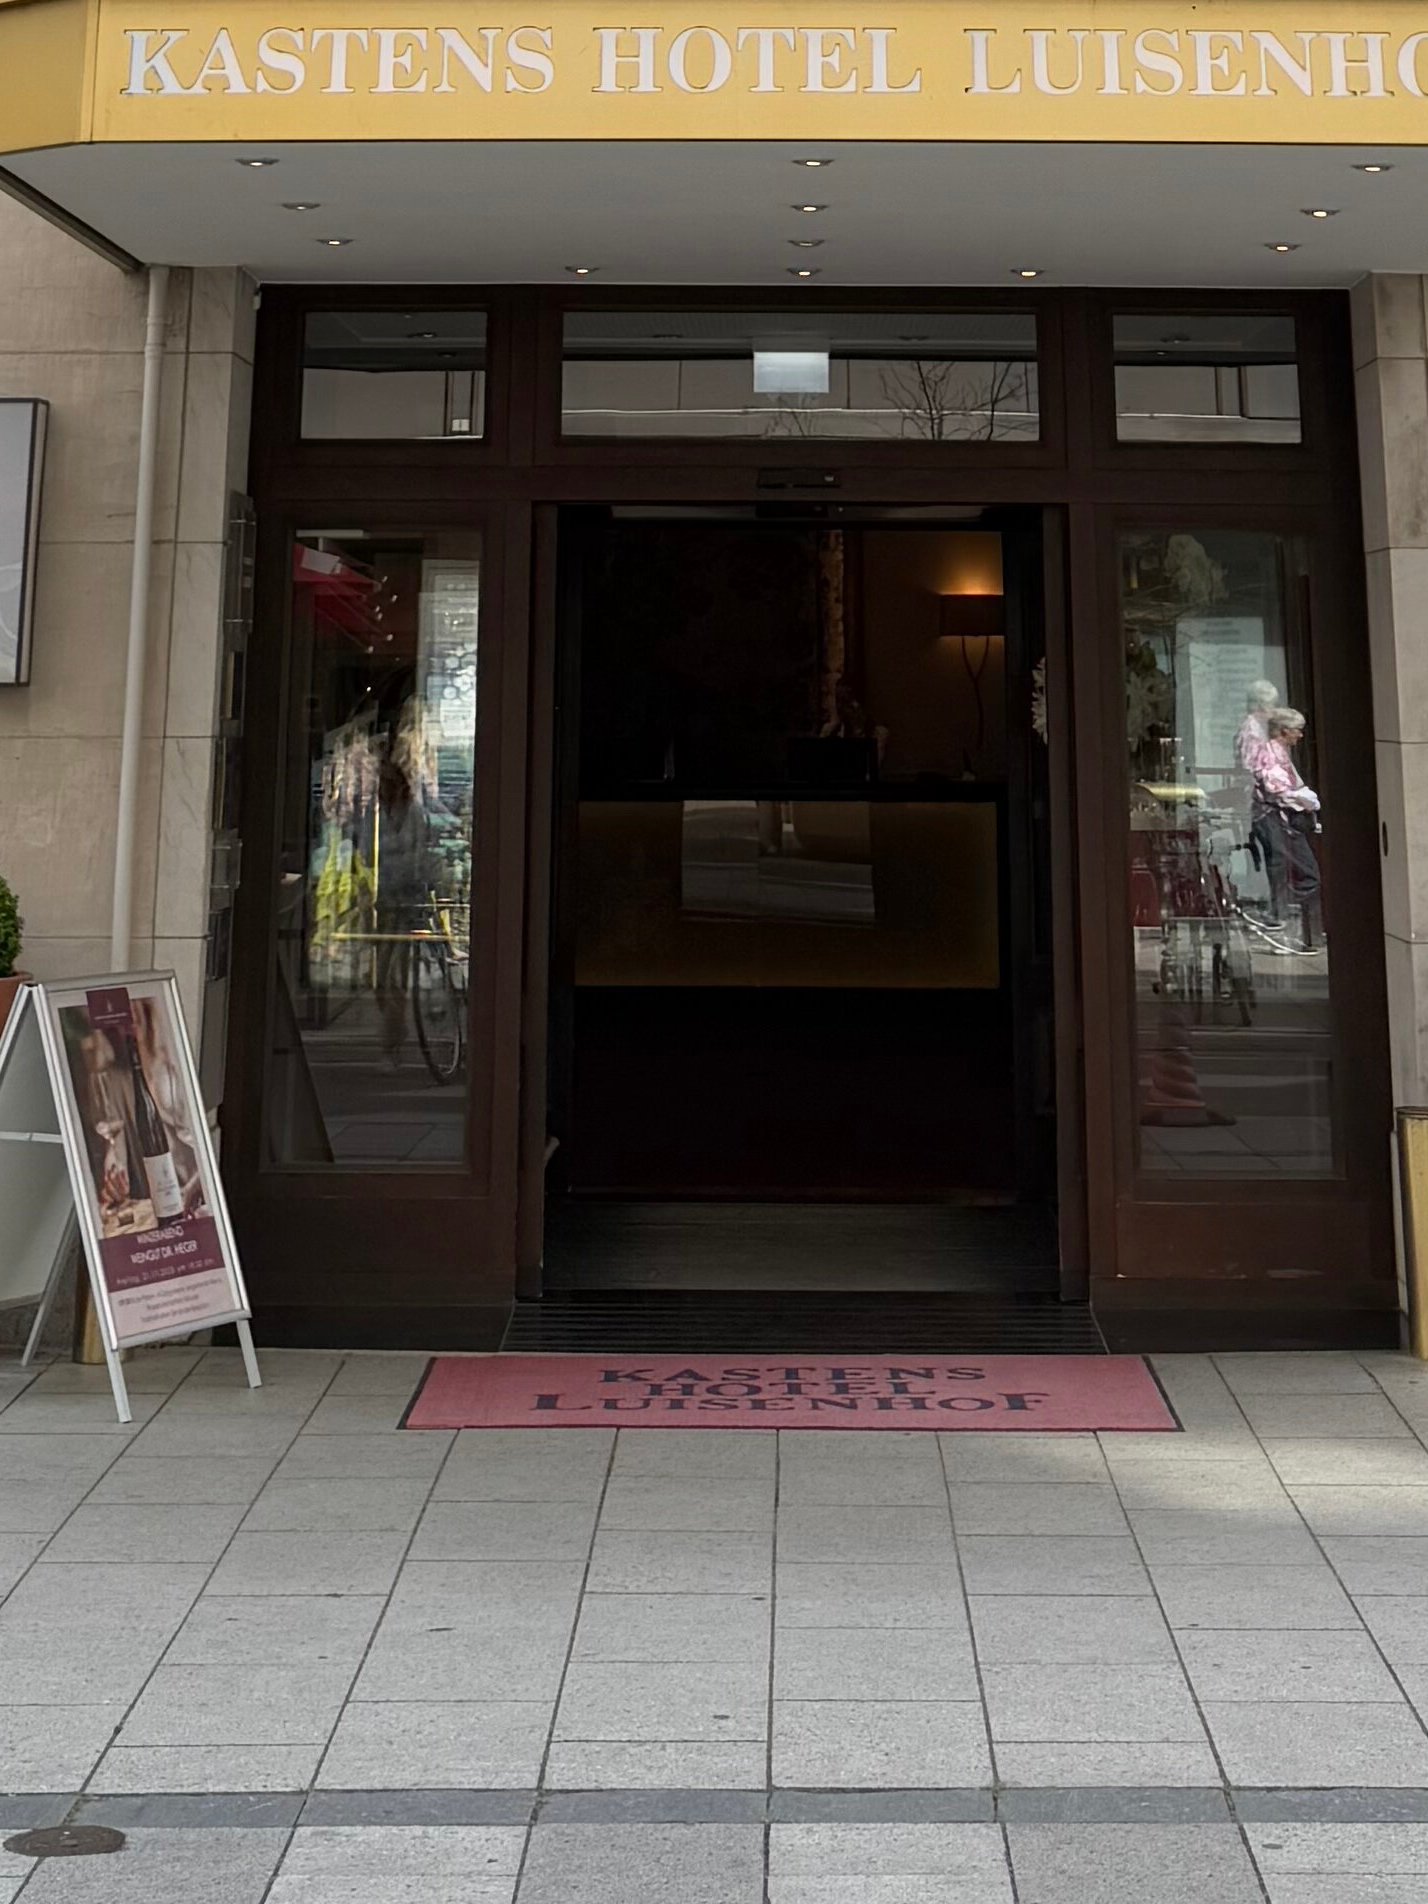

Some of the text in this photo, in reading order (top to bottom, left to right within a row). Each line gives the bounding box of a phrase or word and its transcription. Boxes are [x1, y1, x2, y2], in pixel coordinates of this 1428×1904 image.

[120, 26, 556, 96] KASTENS
[592, 26, 923, 94] HOTEL
[597, 1367, 987, 1383] KASTENS
[647, 1380, 938, 1397] HOTEL
[530, 1392, 1050, 1411] LUISENHOF
